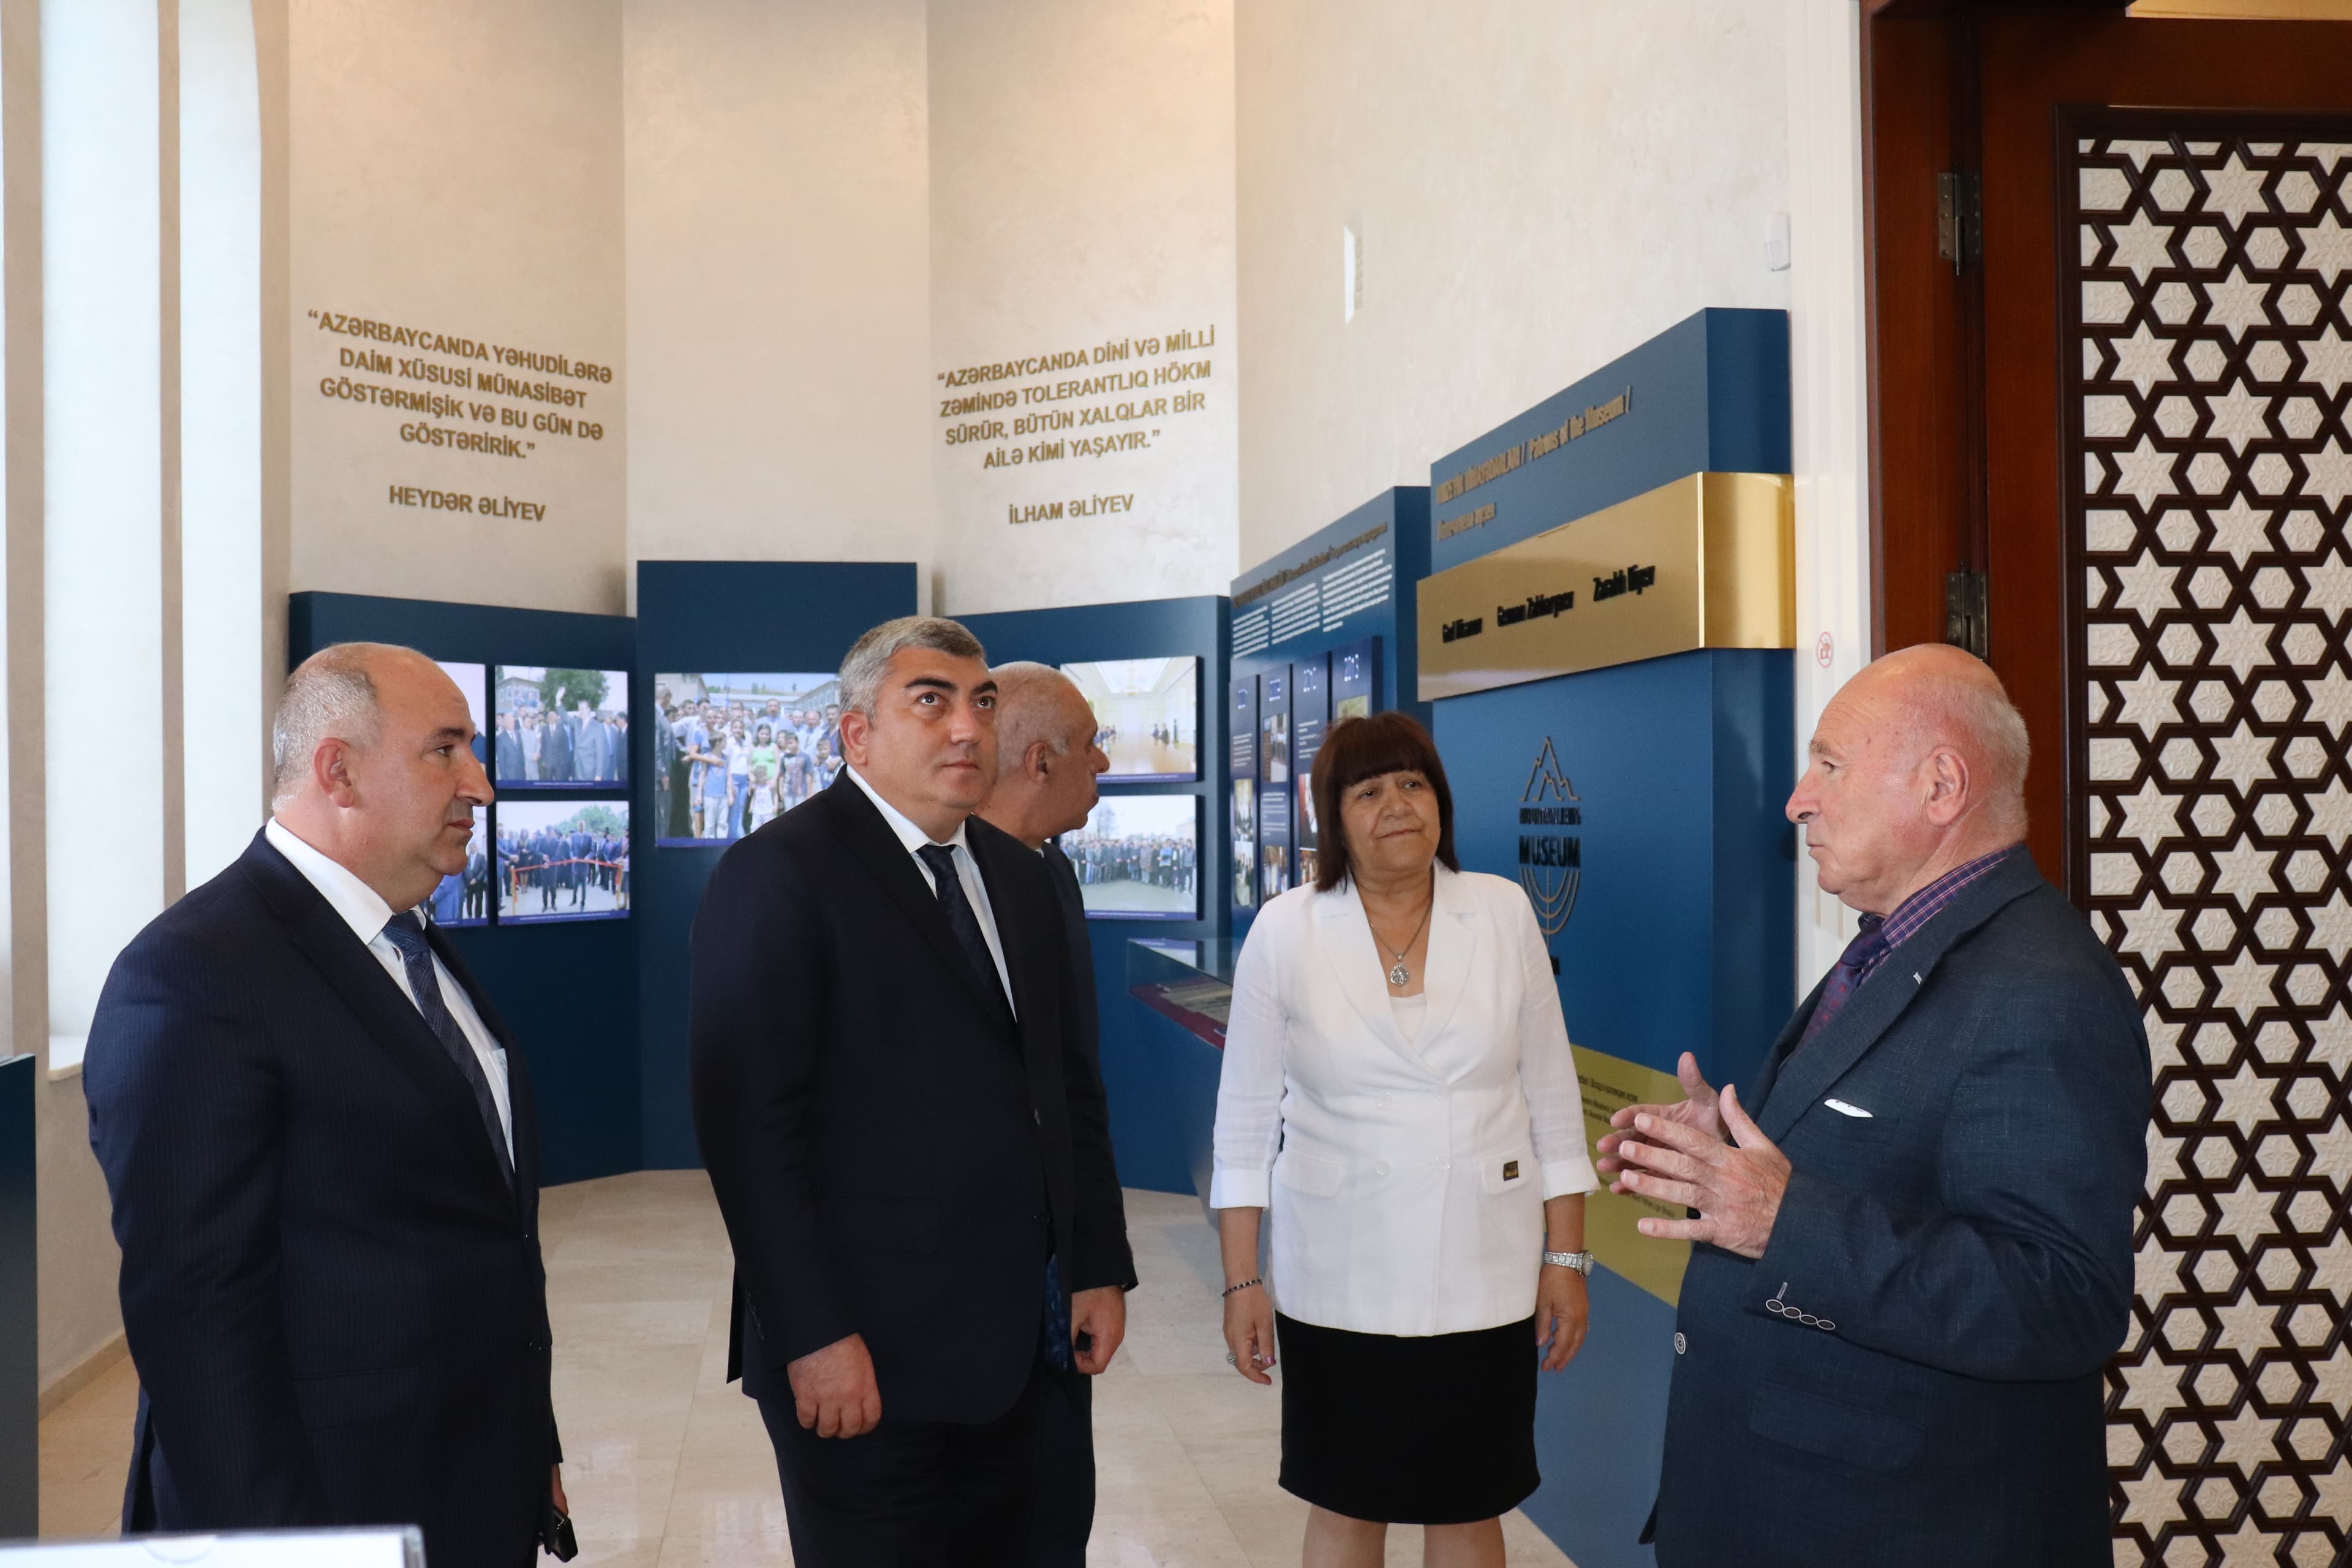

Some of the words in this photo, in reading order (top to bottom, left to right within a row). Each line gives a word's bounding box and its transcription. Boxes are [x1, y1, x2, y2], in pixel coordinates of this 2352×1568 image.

[307, 309, 489, 361] “AZƏRBAYCANDA
[492, 345, 612, 383] YƏHUDİLƏRƏ
[938, 350, 1088, 388] “AZƏRBAYCANDA
[1093, 338, 1129, 364] DİNİ
[1134, 337, 1160, 357] VƏ
[1166, 324, 1215, 353] MİLLİ
[339, 347, 393, 374] DAİM
[398, 358, 472, 388] XÜSUSİ
[477, 372, 587, 409] MÜNASİBƏT
[940, 392, 1017, 418] ZƏMİNDƏ
[1022, 369, 1148, 404] TOLERANTLIQ
[1154, 360, 1211, 384] HÖKM
[320, 377, 464, 418] GÖSTƏRMİŞİK
[469, 402, 496, 423] VƏ
[502, 408, 527, 429] BU
[533, 413, 572, 436] GÜN
[578, 420, 603, 440] DƏ
[945, 420, 1008, 445] SÜRÜR,
[1014, 409, 1074, 435] BÜTÜN
[1079, 398, 1167, 427] XALQLAR
[1173, 390, 1205, 413] BİR
[1585, 394, 1625, 432] Museum
[984, 447, 1023, 469] AİLƏ
[1028, 438, 1065, 463] KİMİ
[389, 485, 473, 513] HEYDƏR
[478, 495, 546, 521] ƏLİYEV
[1009, 503, 1063, 524] İLHAM
[1069, 493, 1134, 518] ƏLİYEV
[1520, 835, 1581, 869] MUSEUM
